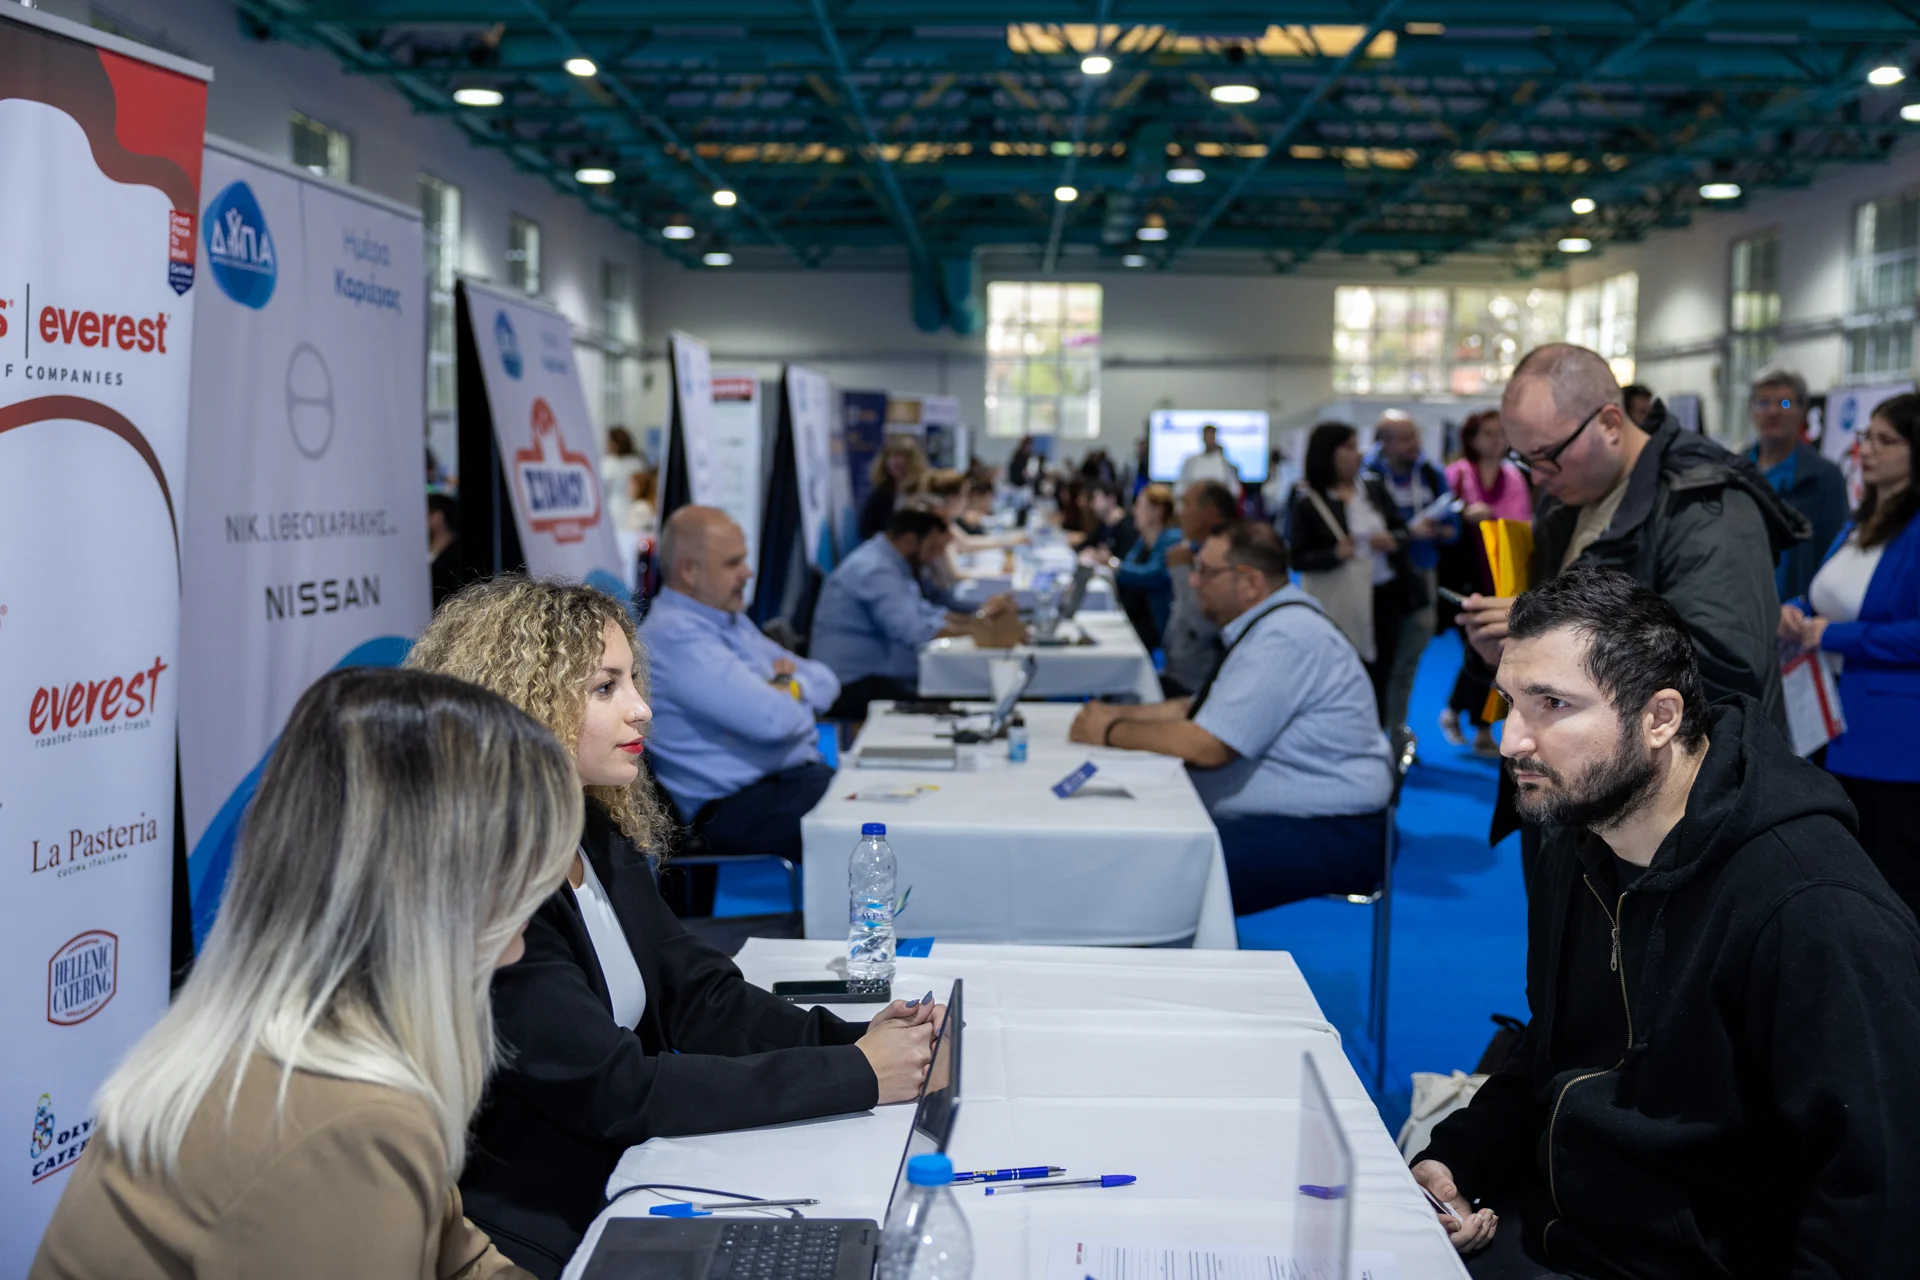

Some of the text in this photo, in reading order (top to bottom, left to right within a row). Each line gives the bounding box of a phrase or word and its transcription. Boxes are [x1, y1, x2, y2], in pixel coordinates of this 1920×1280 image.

[39, 305, 167, 354] everest
[25, 365, 124, 386] COMPANIES
[264, 574, 382, 623] NISSAN
[28, 655, 168, 735] everest
[30, 811, 158, 874] La Pasteria
[54, 943, 113, 988] HELLENIC
[53, 968, 111, 1014] CATERING
